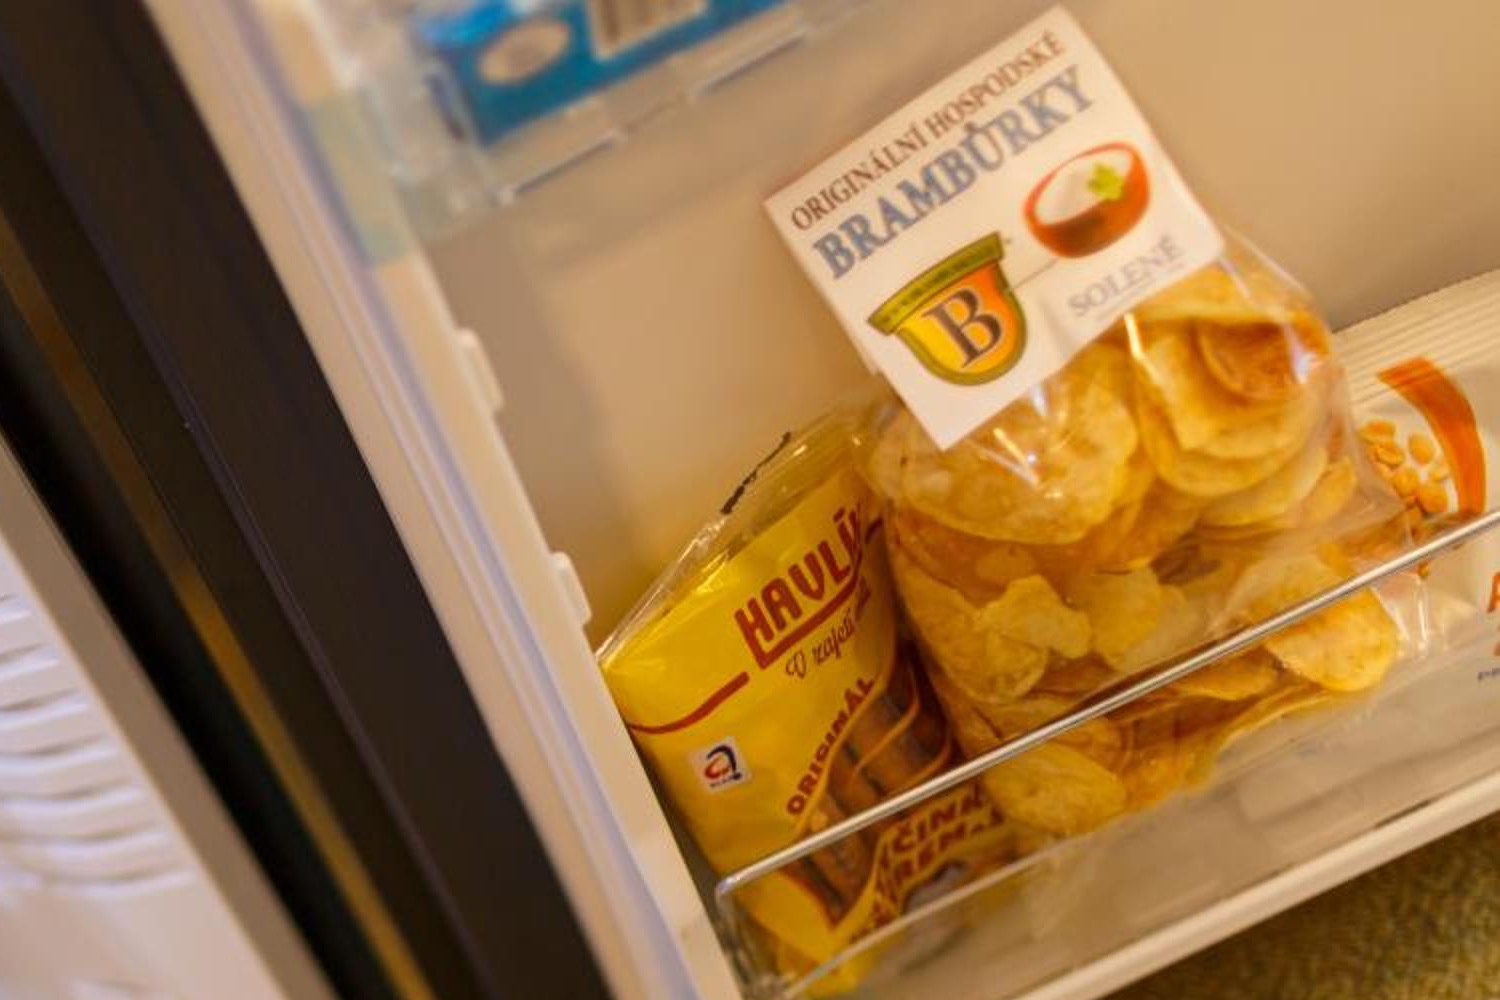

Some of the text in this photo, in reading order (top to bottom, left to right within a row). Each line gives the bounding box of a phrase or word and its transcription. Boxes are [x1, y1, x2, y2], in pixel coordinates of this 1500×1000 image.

[791, 29, 1065, 231] ORIGINÁLNÍ HOSPODSKÉ
[812, 63, 1094, 280] BRAMBŮRKY
[920, 286, 1002, 369] B
[1068, 233, 1183, 318] SOLENÉ
[786, 677, 875, 815] ORIGINÁL
